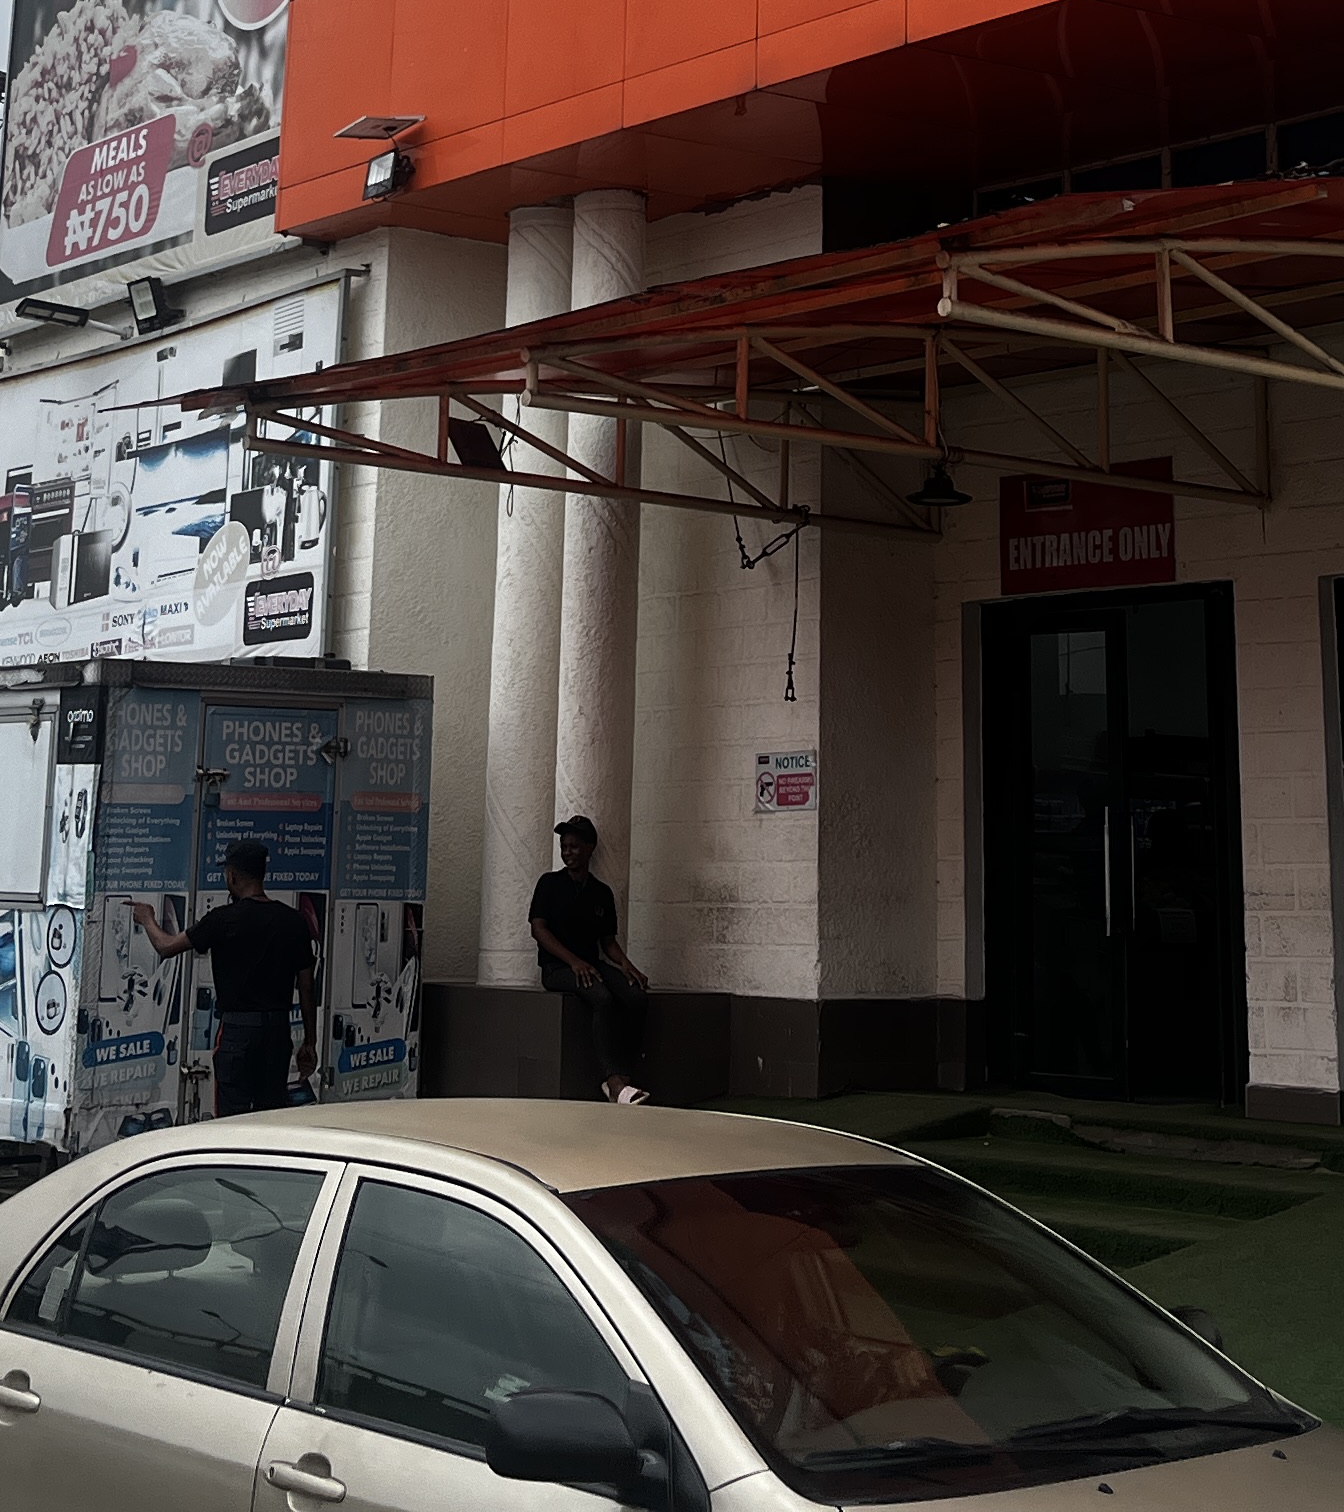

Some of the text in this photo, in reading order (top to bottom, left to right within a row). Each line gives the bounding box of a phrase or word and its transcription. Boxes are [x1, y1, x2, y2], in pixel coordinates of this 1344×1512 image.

[90, 128, 149, 175] MEALS
[77, 161, 146, 204] AS LOW AS
[202, 535, 228, 579] NOW
[1008, 522, 1172, 571] ENTRANCE ONLY
[111, 613, 136, 627] SONY
[159, 603, 183, 616] MAXI
[255, 588, 313, 618] EVERYDAY
[260, 613, 309, 631] Supermarket
[37, 652, 61, 664] AEON
[176, 703, 187, 728] &
[356, 710, 410, 735] PHONES
[222, 720, 323, 743] PHONES &
[225, 743, 317, 765] GADGETS
[357, 737, 421, 761] GADGETS
[121, 754, 167, 778] SHOP
[369, 761, 406, 785] SHOP
[775, 755, 811, 769] NOTICE
[244, 767, 298, 788] SHOP
[206, 872, 320, 883] GET FIXED TODAY
[96, 1039, 151, 1063] WE SALE
[349, 1046, 395, 1068] WE SALE
[110, 1062, 157, 1083] REPAIR
[342, 1069, 401, 1096] WE REPAIR
